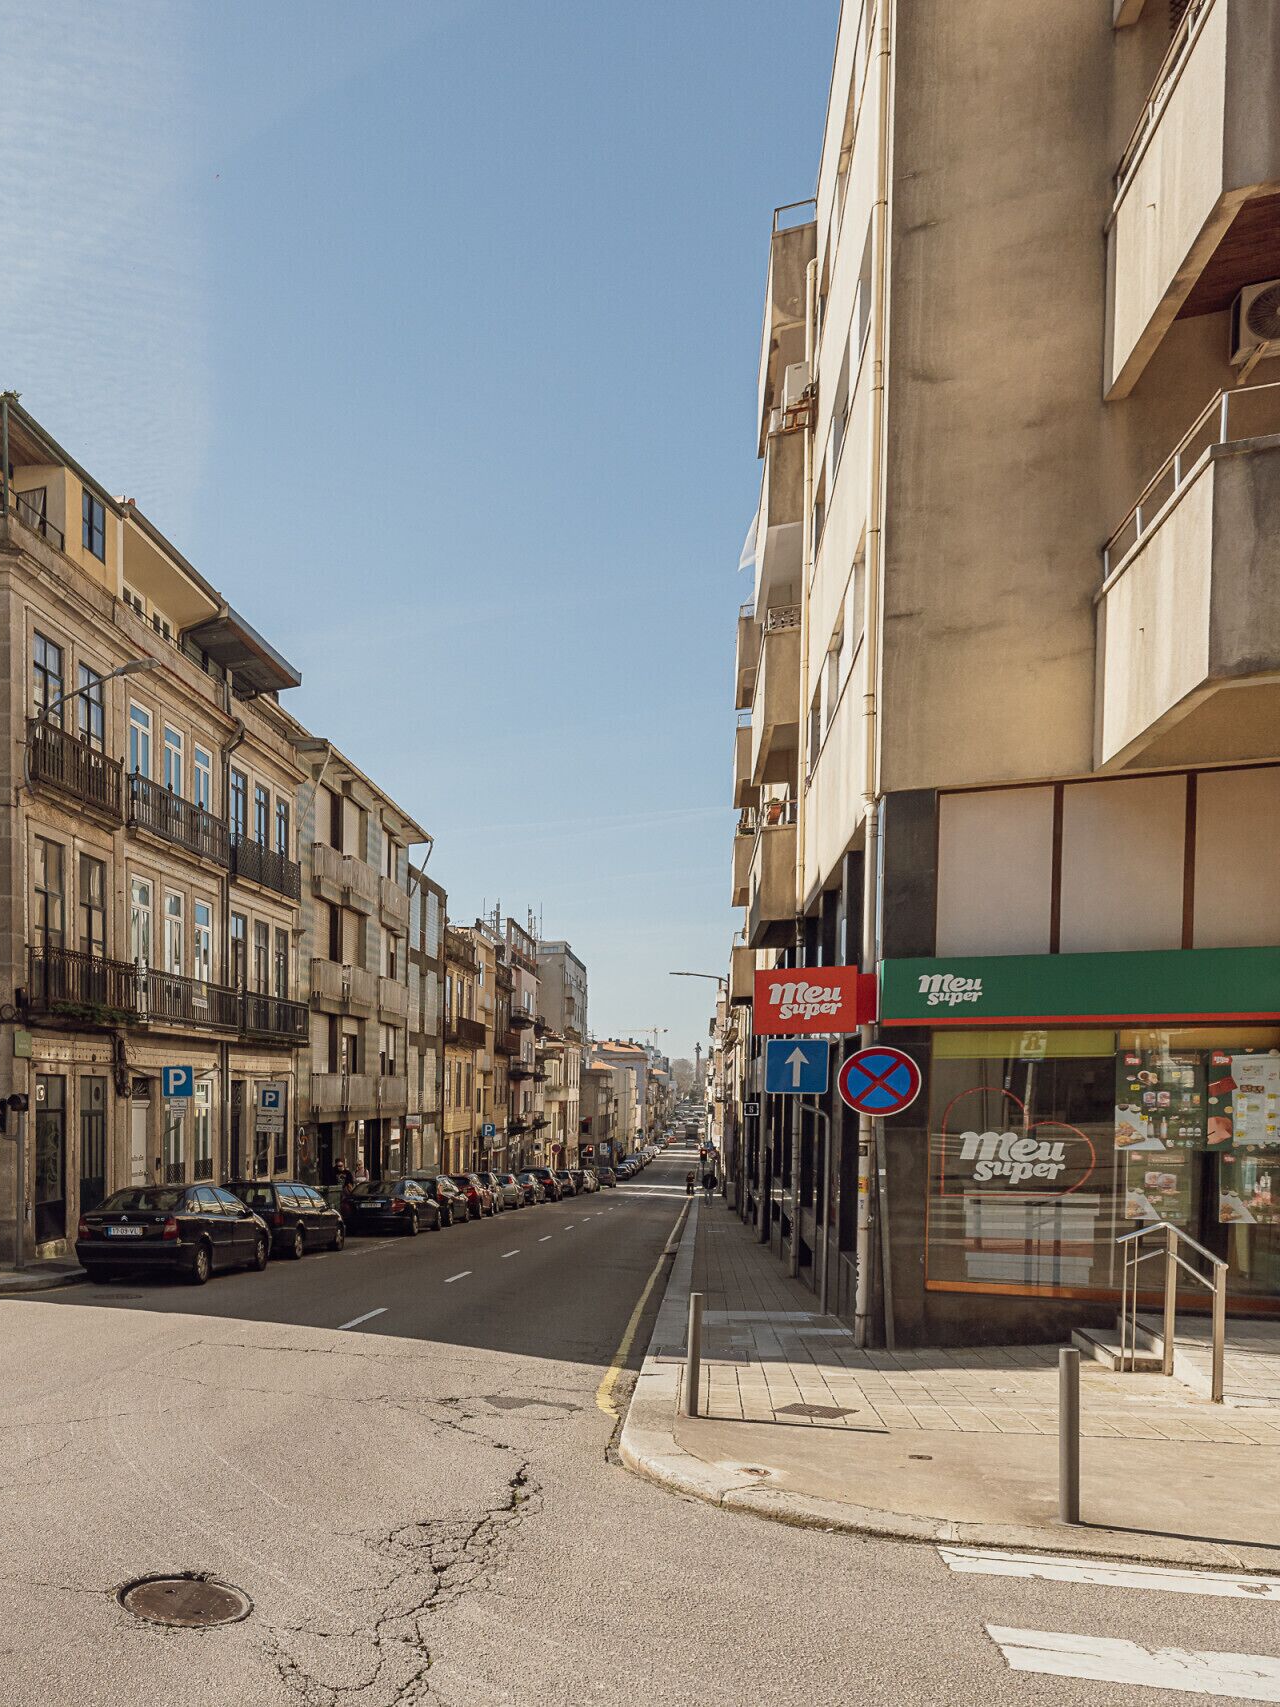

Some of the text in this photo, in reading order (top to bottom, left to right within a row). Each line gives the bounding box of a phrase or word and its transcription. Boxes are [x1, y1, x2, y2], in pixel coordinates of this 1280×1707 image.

[769, 982, 841, 1004] Meu
[919, 974, 982, 992] Meu
[927, 991, 983, 1006] super
[779, 1002, 843, 1020] super
[169, 1069, 186, 1094] P
[265, 1092, 276, 1106] P
[960, 1131, 1065, 1162] Meu
[973, 1160, 1065, 1184] super
